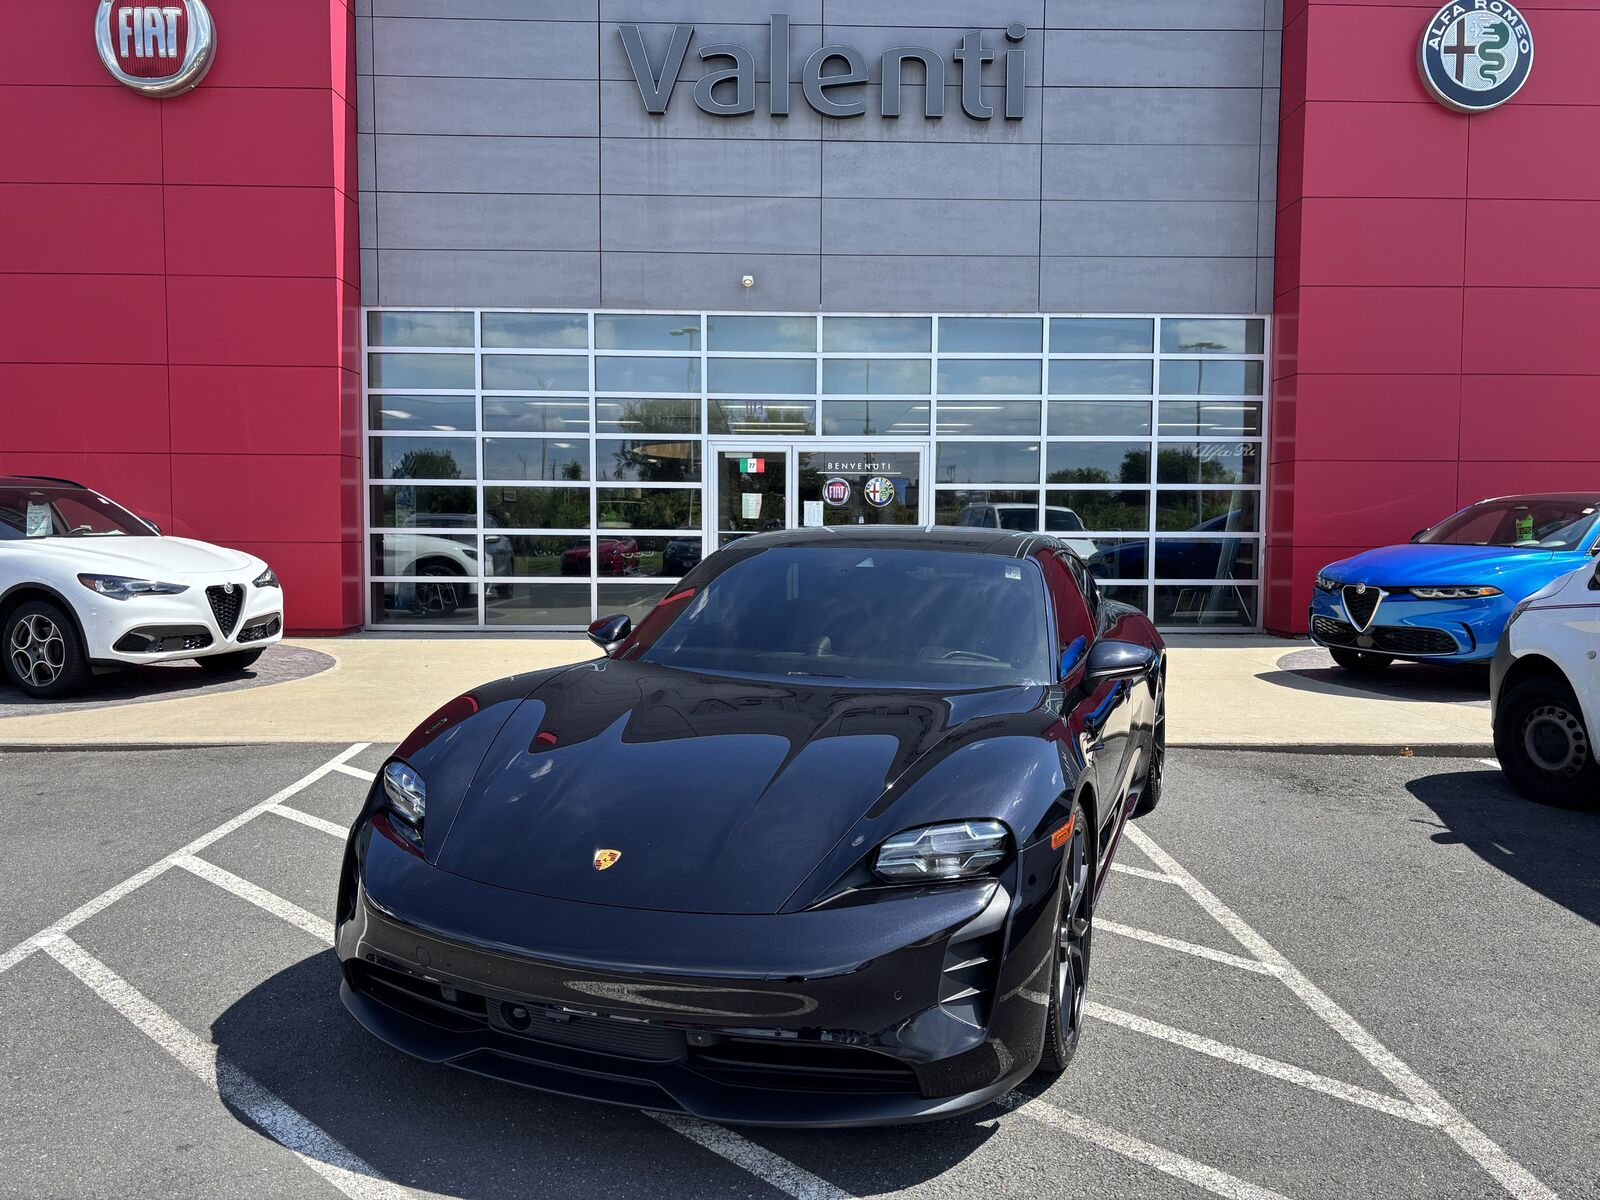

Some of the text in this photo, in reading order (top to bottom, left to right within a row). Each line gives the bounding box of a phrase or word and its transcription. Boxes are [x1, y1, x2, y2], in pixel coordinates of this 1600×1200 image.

[118, 6, 182, 58] FIAT
[1428, 0, 1530, 54] ALFA ROMEO
[617, 13, 1028, 121] Valenti
[827, 462, 891, 470] BENVENUTI
[828, 485, 846, 499] FIAT
